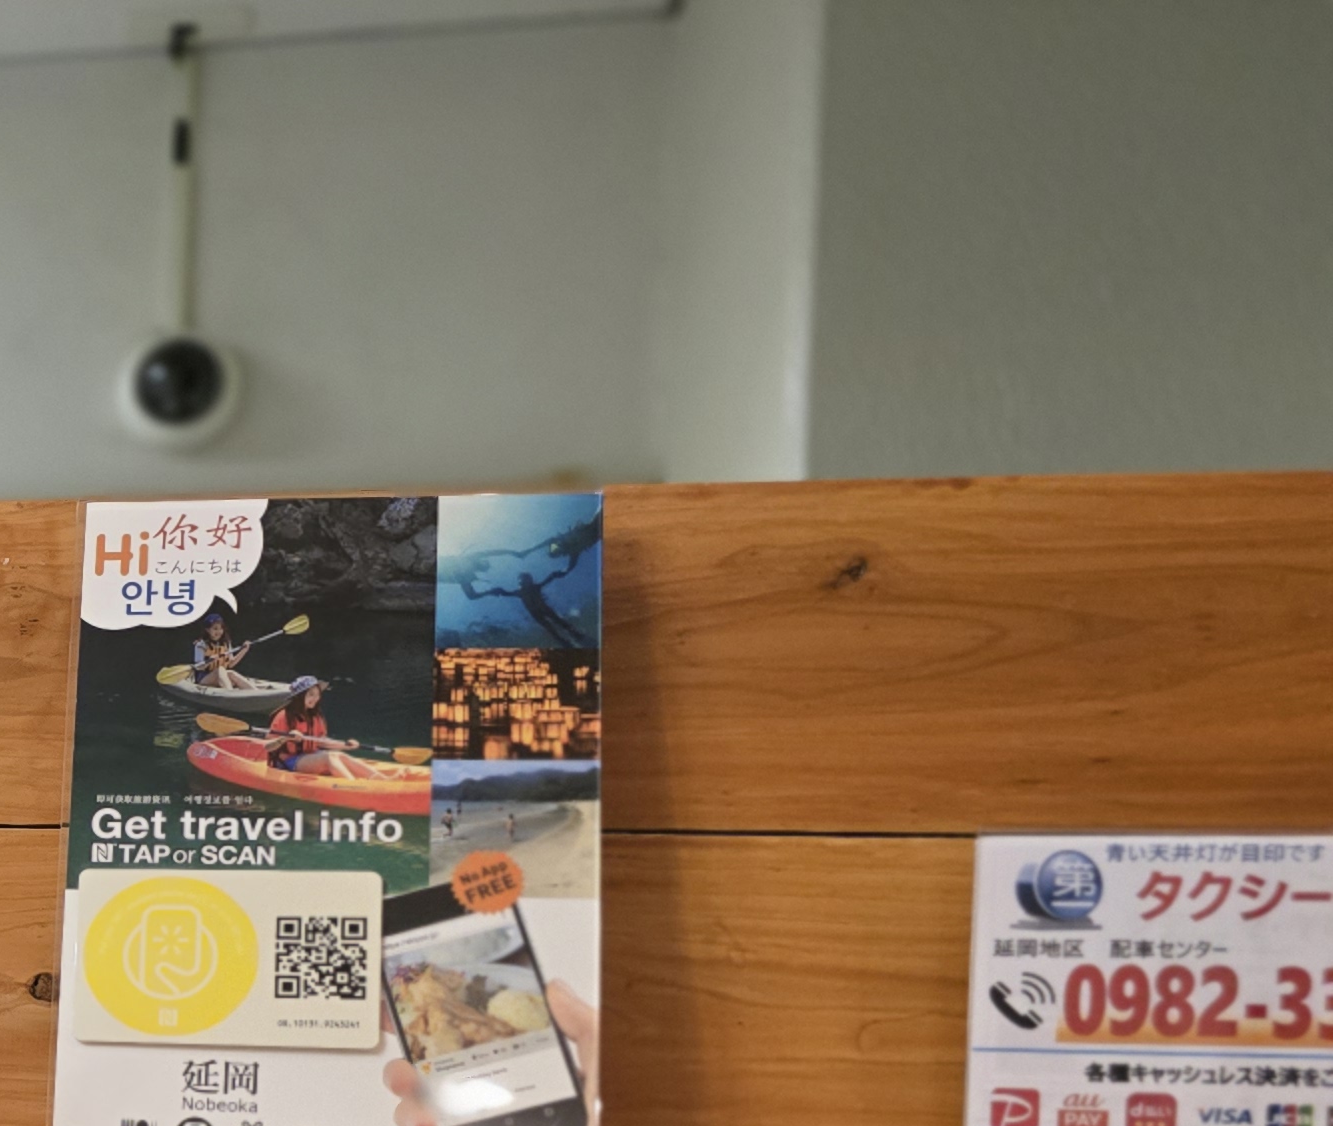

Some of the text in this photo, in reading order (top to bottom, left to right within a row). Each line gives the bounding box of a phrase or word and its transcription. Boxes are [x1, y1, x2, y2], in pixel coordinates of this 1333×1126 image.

[152, 513, 253, 551] 你好
[95, 531, 149, 577] Hi
[154, 558, 242, 575] こんにちは
[121, 578, 196, 616] 안녕
[91, 806, 403, 844] Get travel info
[119, 843, 276, 866] TAP or SCAN
[465, 873, 517, 905] FREE
[1136, 870, 1333, 922] タクシー
[993, 938, 1229, 960] 延岡地区 配車センター
[181, 1059, 260, 1096] 延岡
[181, 1096, 259, 1114] Nobeoka
[1198, 1107, 1254, 1125] VISA
